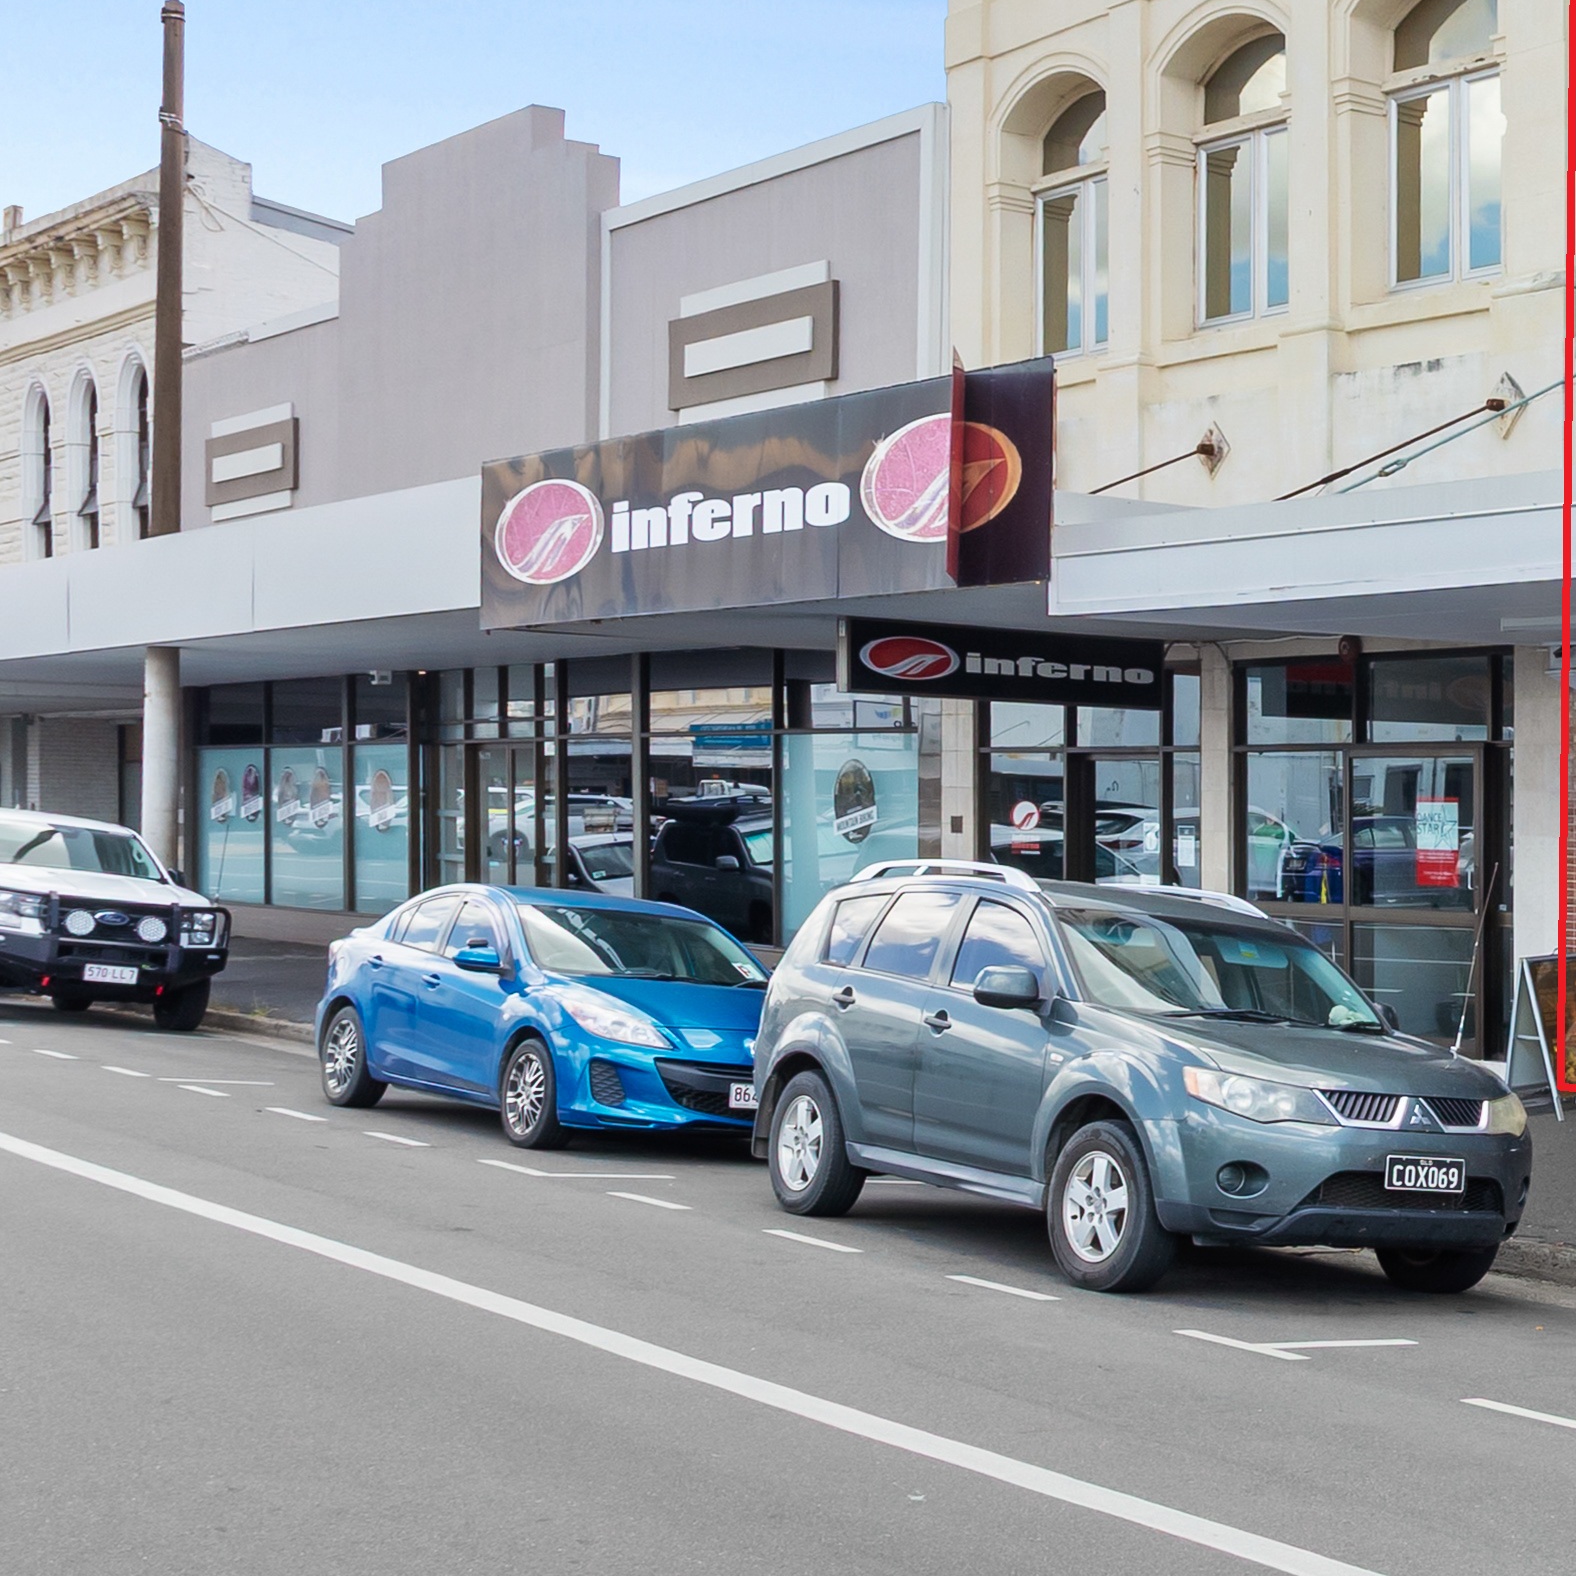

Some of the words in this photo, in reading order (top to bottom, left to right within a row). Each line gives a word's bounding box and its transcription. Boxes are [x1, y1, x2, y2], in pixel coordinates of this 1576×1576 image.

[611, 482, 851, 553] inferno
[965, 652, 1154, 684] inferno
[1392, 1164, 1459, 1189] COX069
